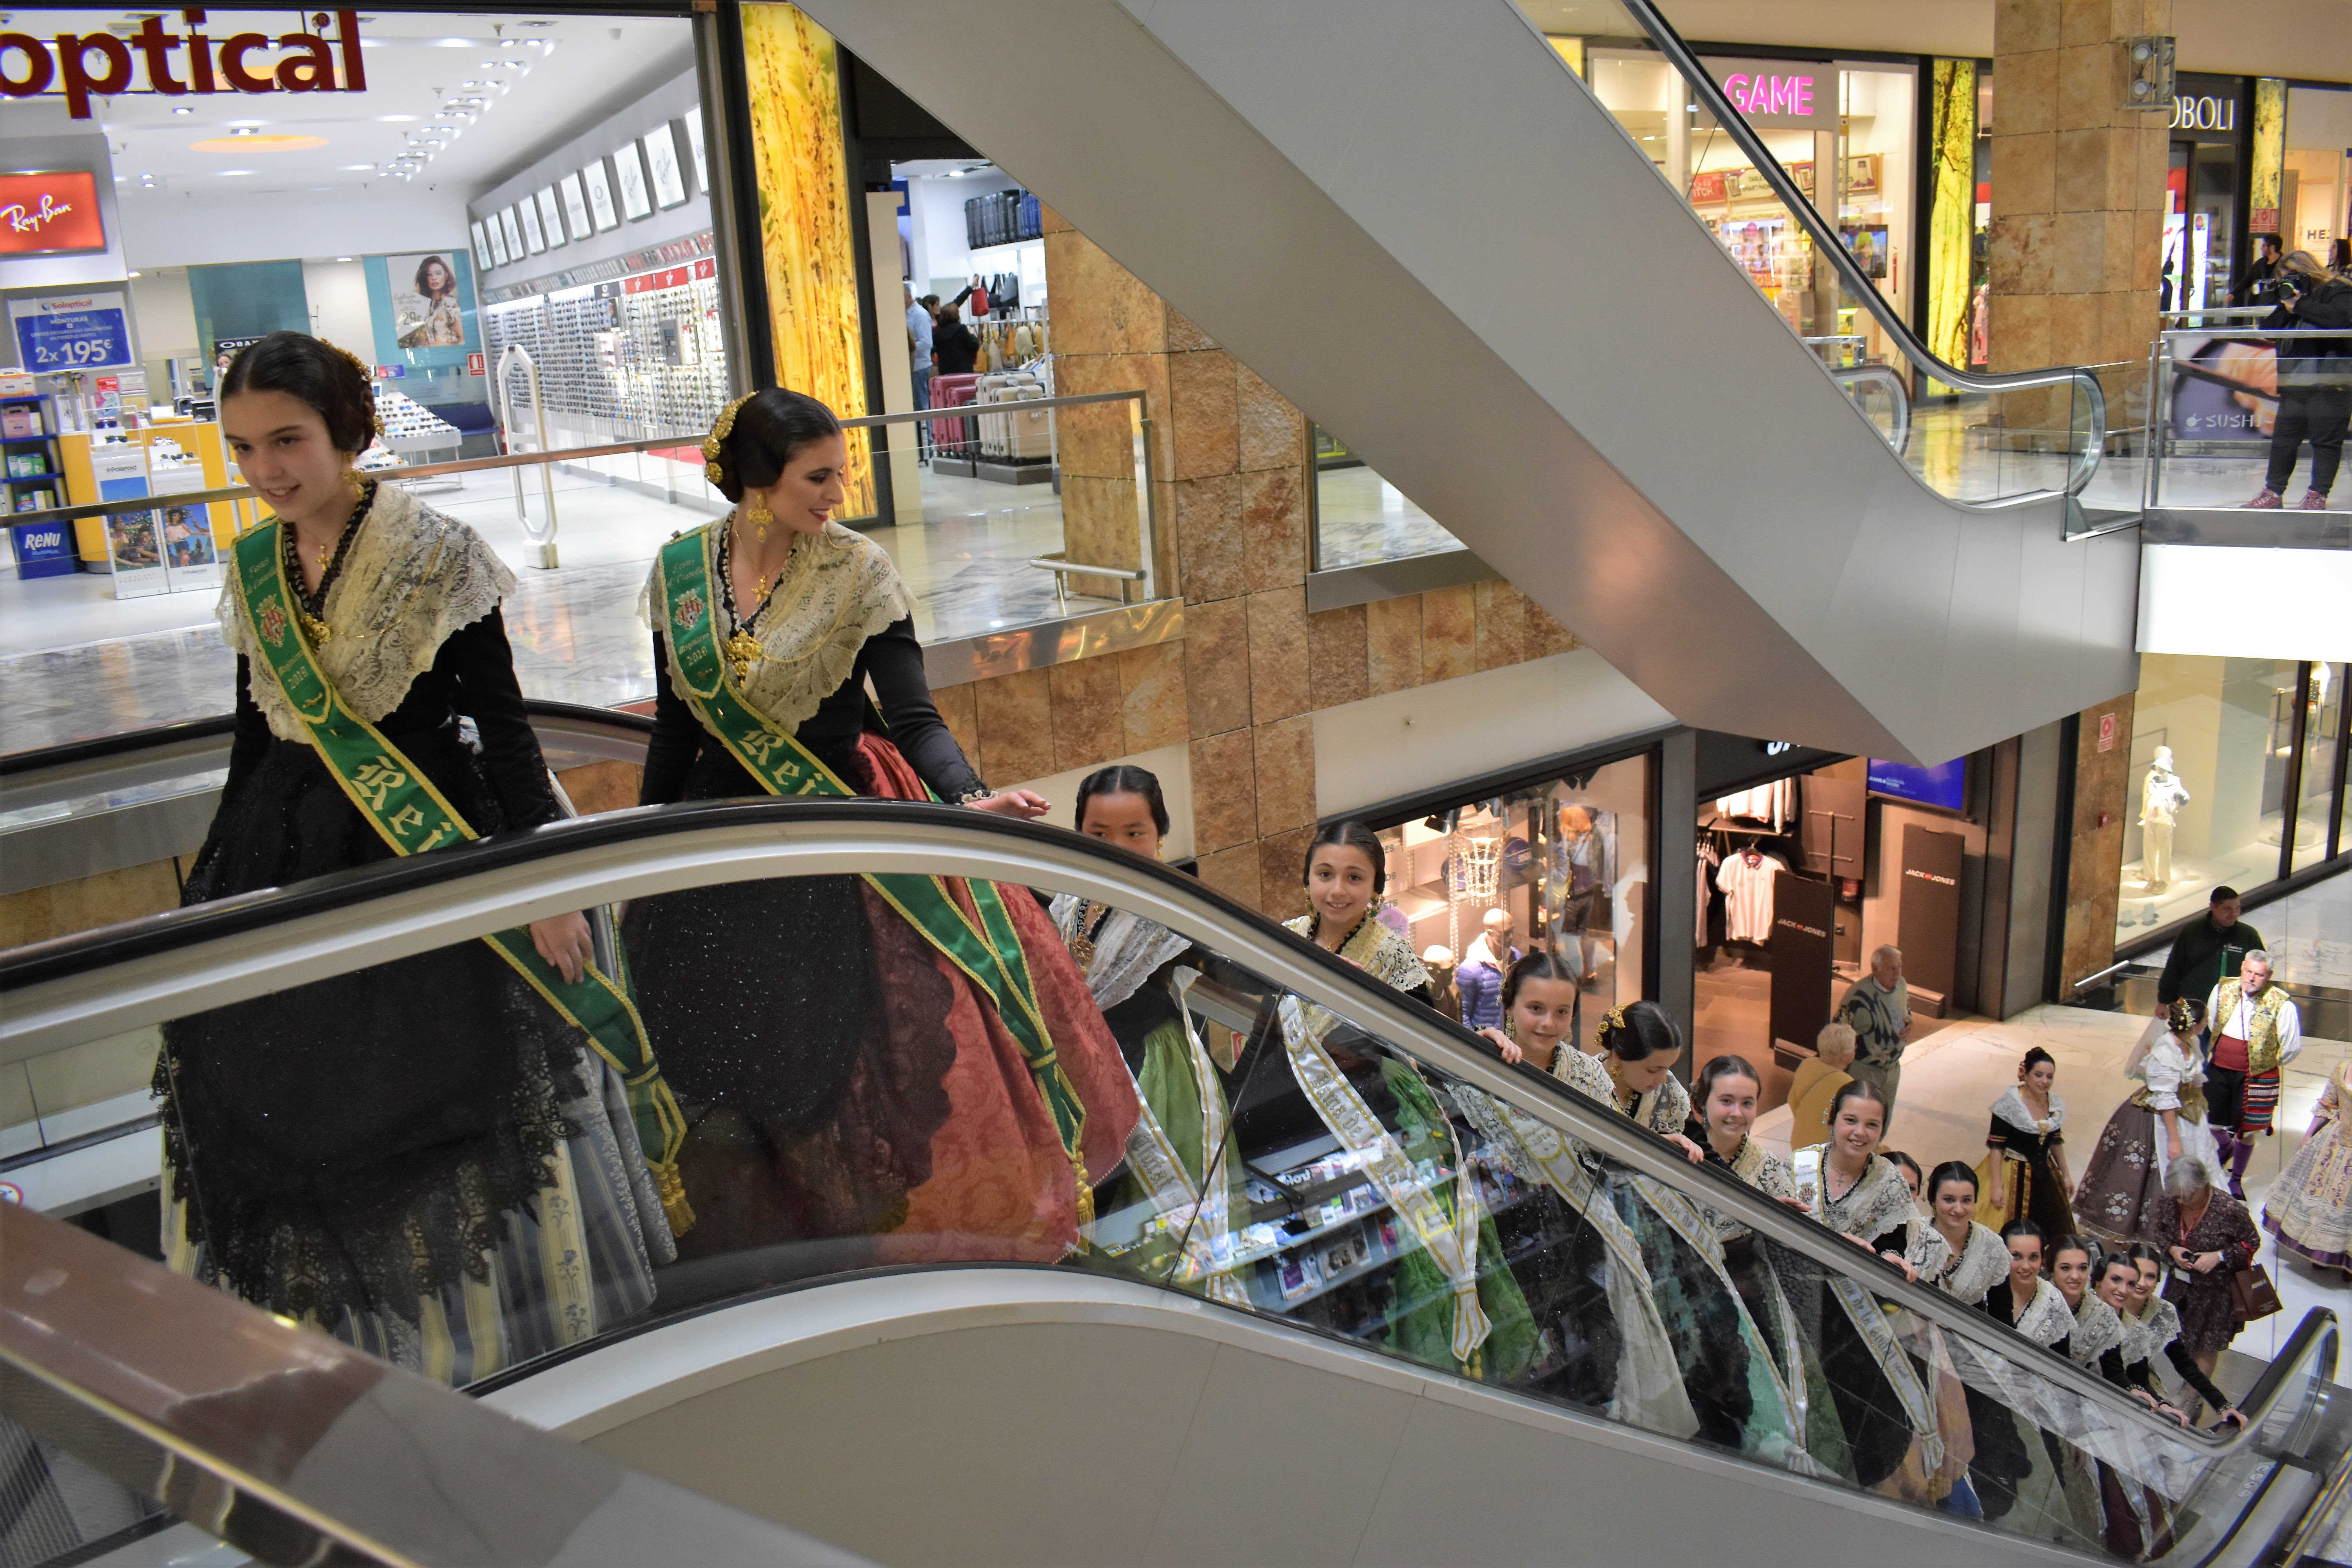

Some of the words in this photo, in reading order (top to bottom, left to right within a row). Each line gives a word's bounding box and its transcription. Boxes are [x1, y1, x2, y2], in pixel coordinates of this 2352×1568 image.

[0, 9, 367, 119] optical
[1724, 73, 1814, 115] GAME
[1692, 186, 1714, 197] ITCH
[52, 299, 93, 309] Soloptical
[36, 347, 59, 363] 2x
[687, 646, 707, 666] 2019
[288, 666, 309, 690] 2019
[738, 726, 828, 795] Rei
[349, 756, 453, 853] Rei
[1906, 869, 1925, 878] JACK
[1931, 875, 1956, 885] JONES
[1777, 919, 1797, 928] JACK
[1803, 926, 1827, 937] JONES
[1310, 1071, 1347, 1119] Dama
[1343, 1112, 1363, 1138] de
